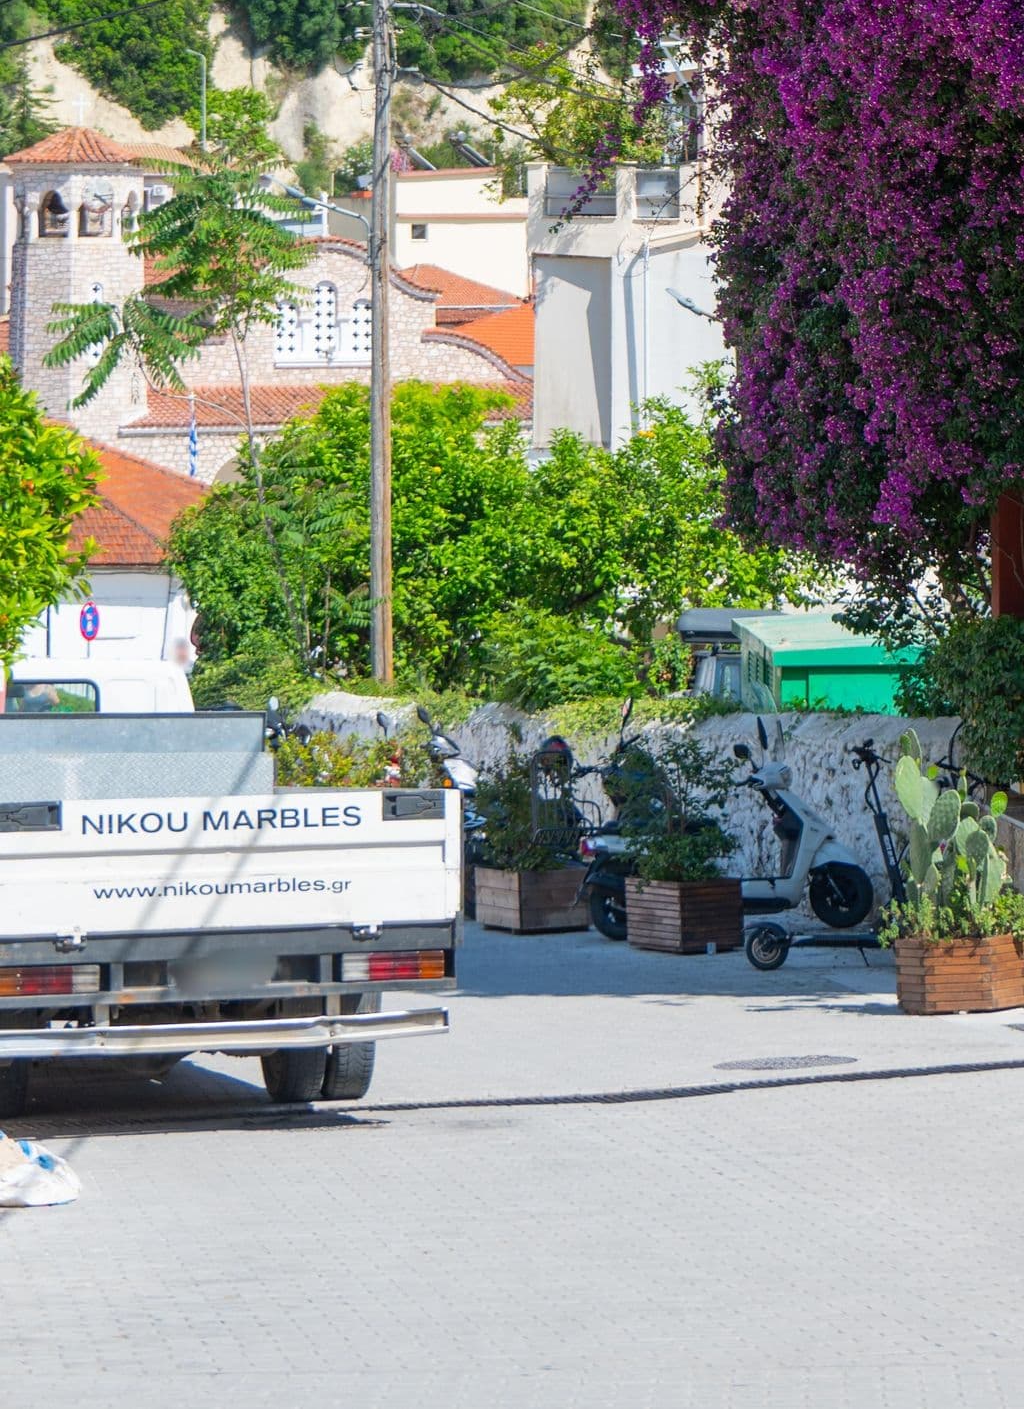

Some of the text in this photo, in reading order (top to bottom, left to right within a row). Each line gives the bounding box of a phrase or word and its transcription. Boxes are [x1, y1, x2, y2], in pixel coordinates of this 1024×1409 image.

[81, 805, 362, 835] NIKOU MARBLES
[93, 877, 352, 899] www.nikoumarbles.gr
